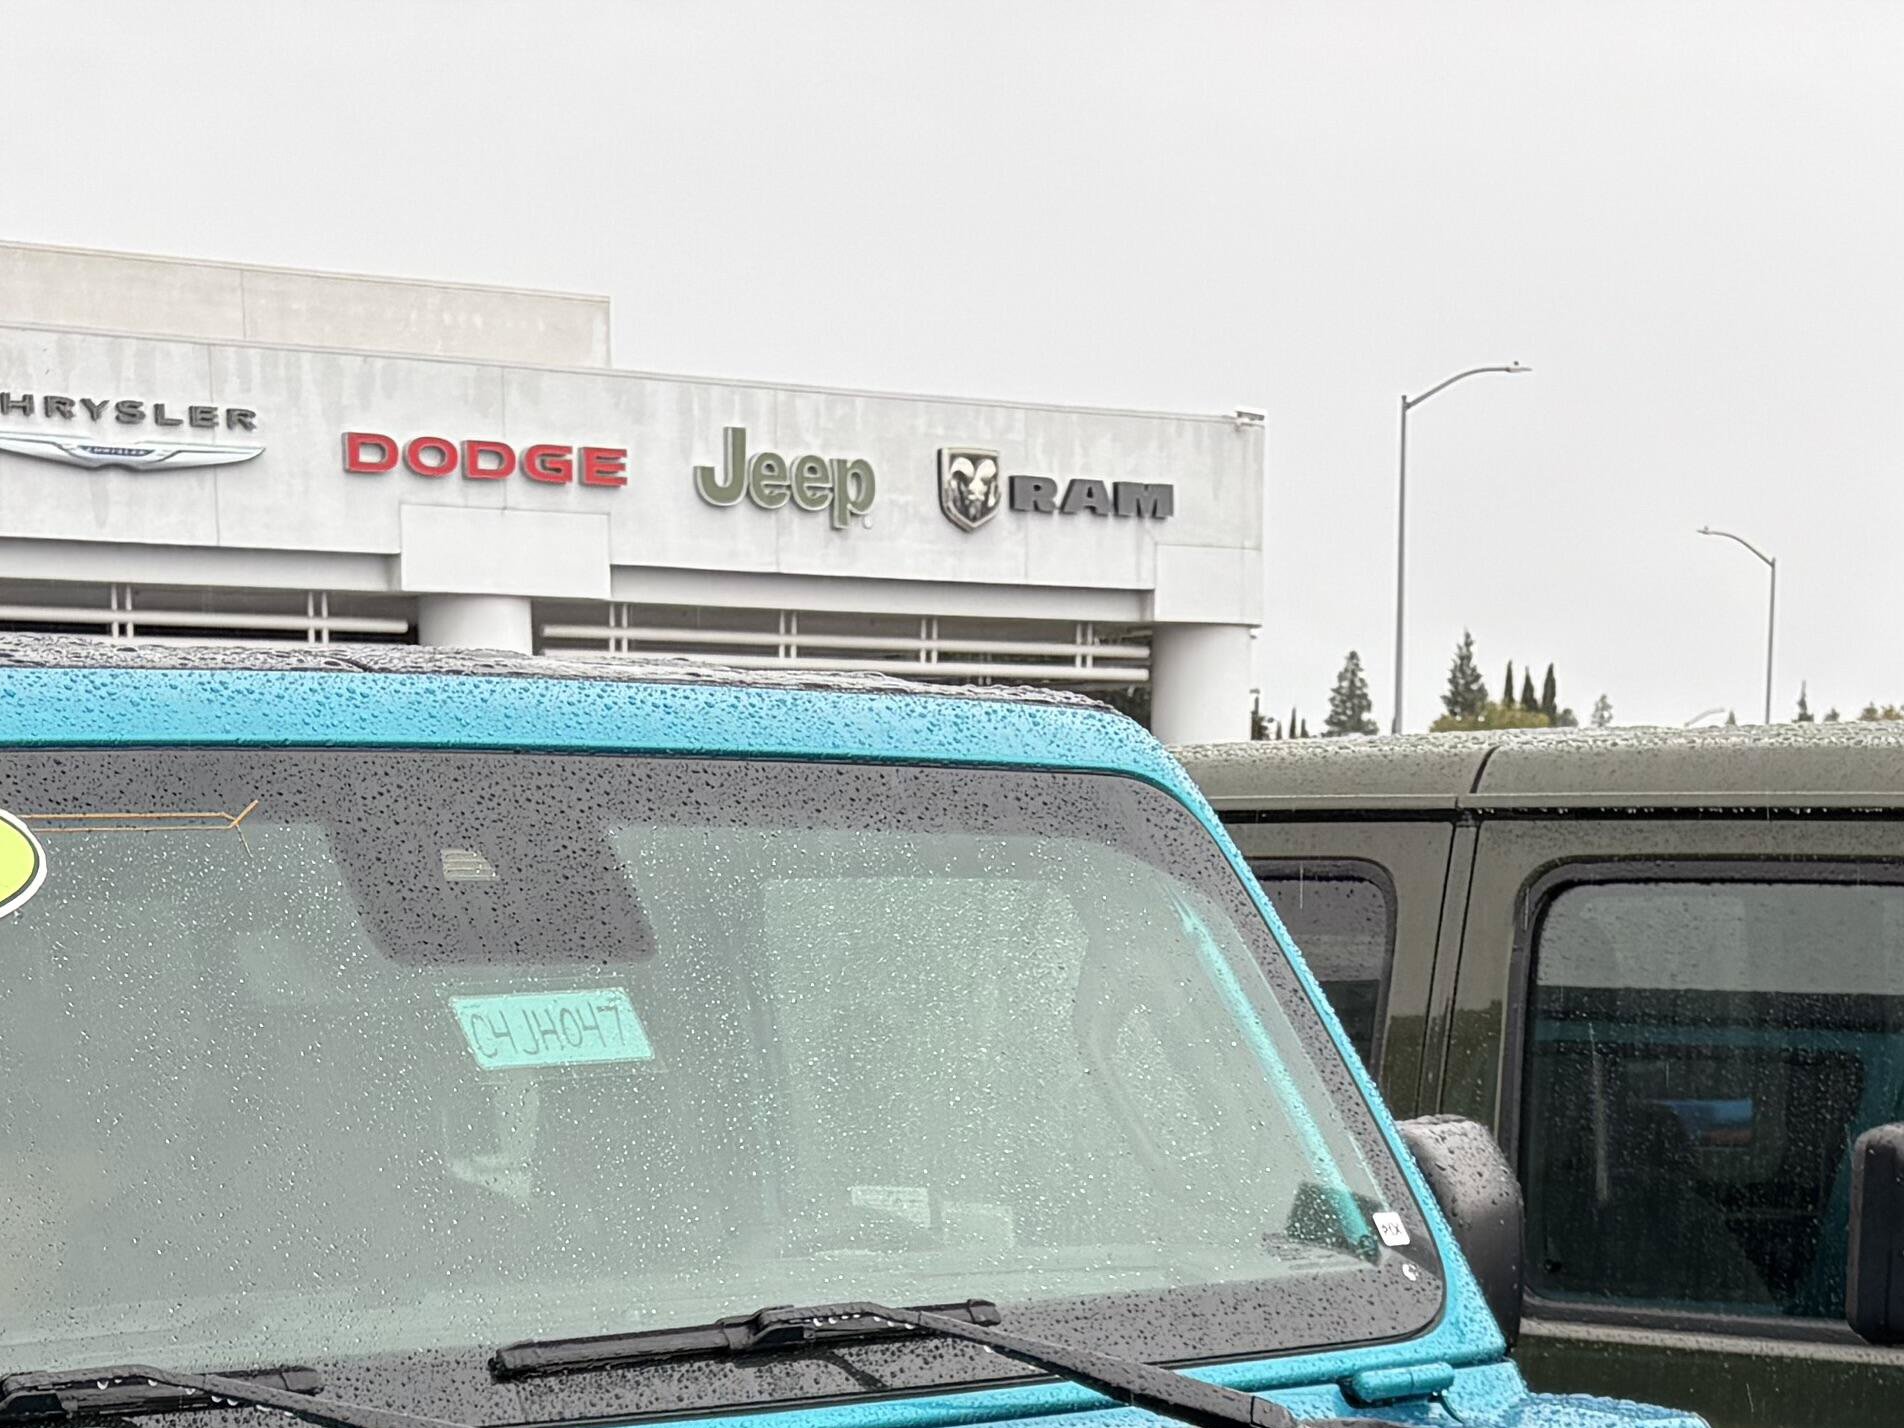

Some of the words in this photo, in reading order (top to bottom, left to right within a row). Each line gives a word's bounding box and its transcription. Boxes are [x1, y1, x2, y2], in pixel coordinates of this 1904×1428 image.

[341, 431, 628, 487] DODGE
[696, 427, 877, 530] Jeep
[1010, 475, 1175, 518] RAM
